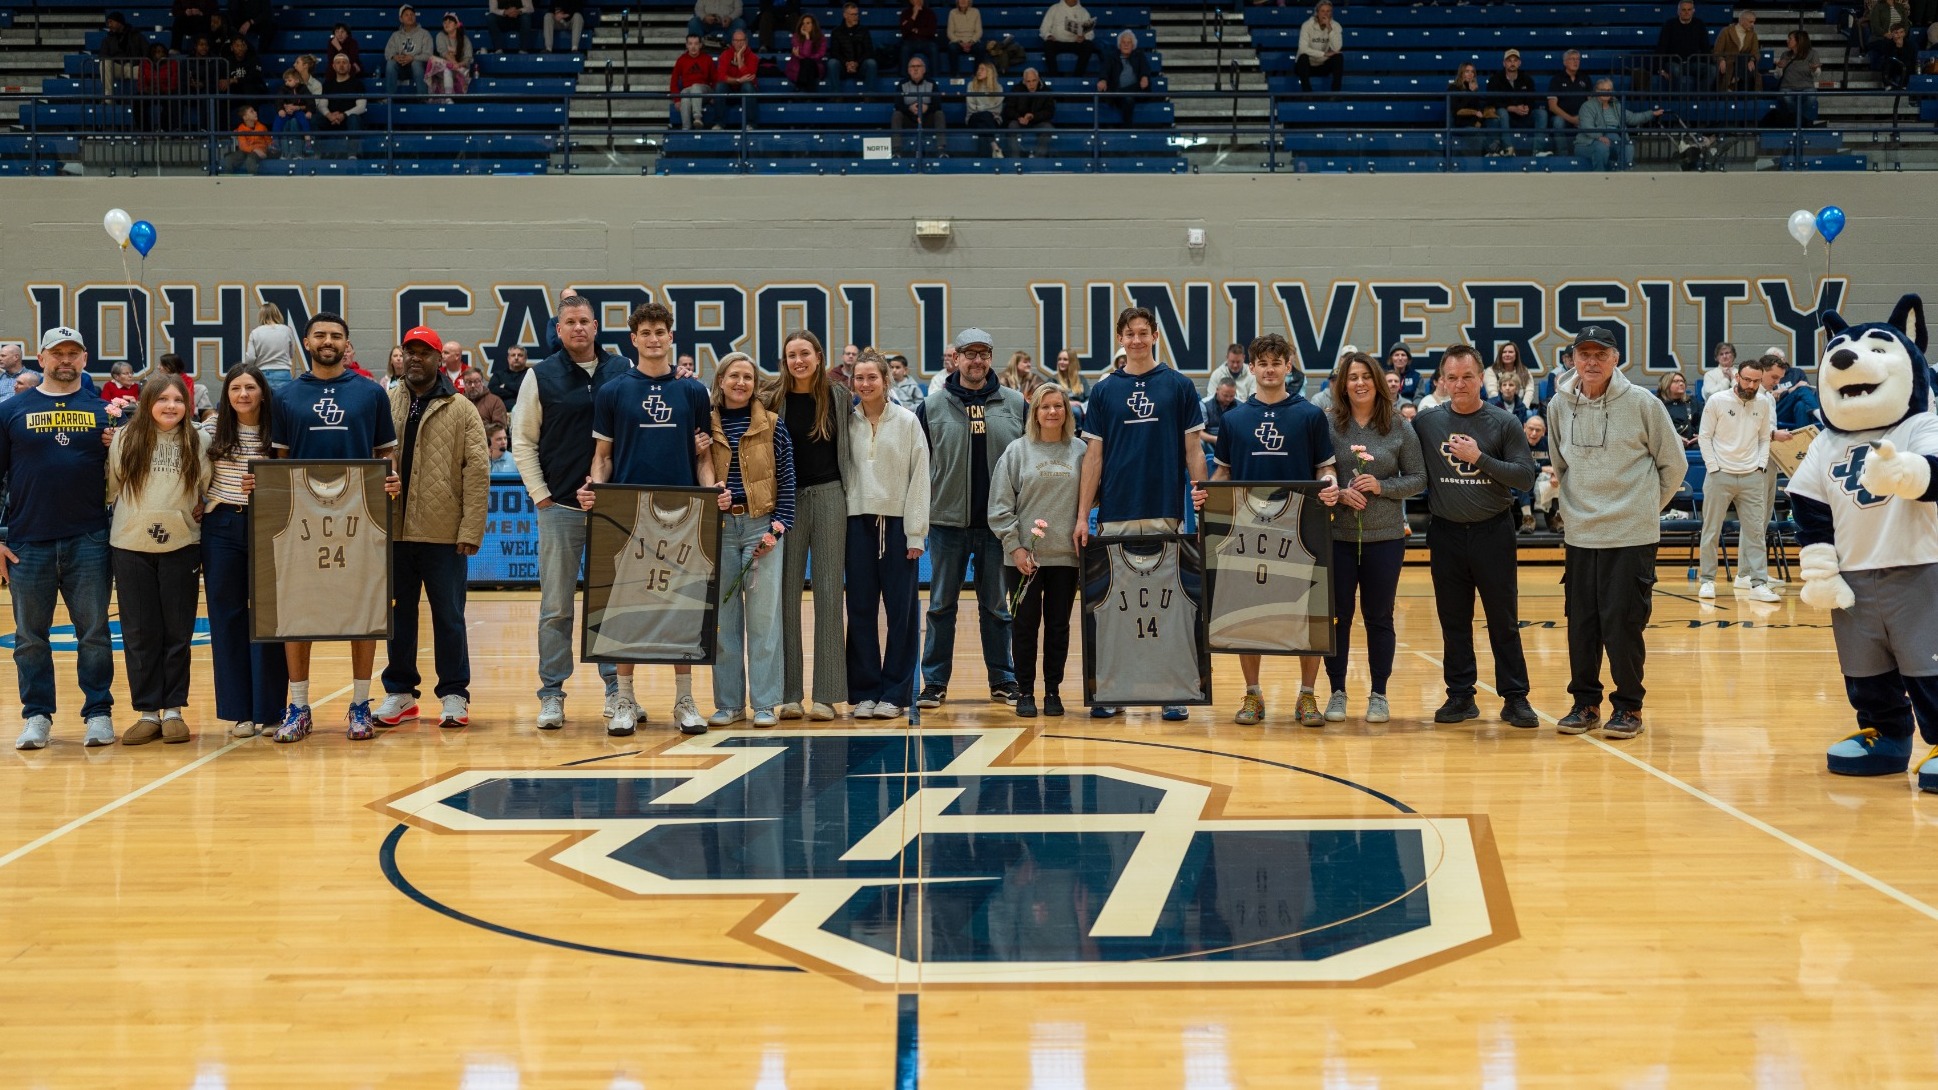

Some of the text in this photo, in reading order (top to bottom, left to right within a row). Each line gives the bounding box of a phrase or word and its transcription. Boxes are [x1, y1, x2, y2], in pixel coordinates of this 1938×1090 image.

[2, 279, 1847, 378] JOHN CARROLL UNIVERSITY
[29, 411, 94, 427] JOHN CARROLL
[1440, 477, 1492, 485] BASKETBALL
[300, 515, 360, 541] JCU
[318, 545, 346, 569] 24
[634, 537, 692, 566] JCU
[1236, 533, 1292, 559] JCU
[646, 568, 671, 592] 15
[1256, 563, 1267, 585] 0
[1119, 587, 1173, 611] JCU
[1136, 616, 1158, 639] 14
